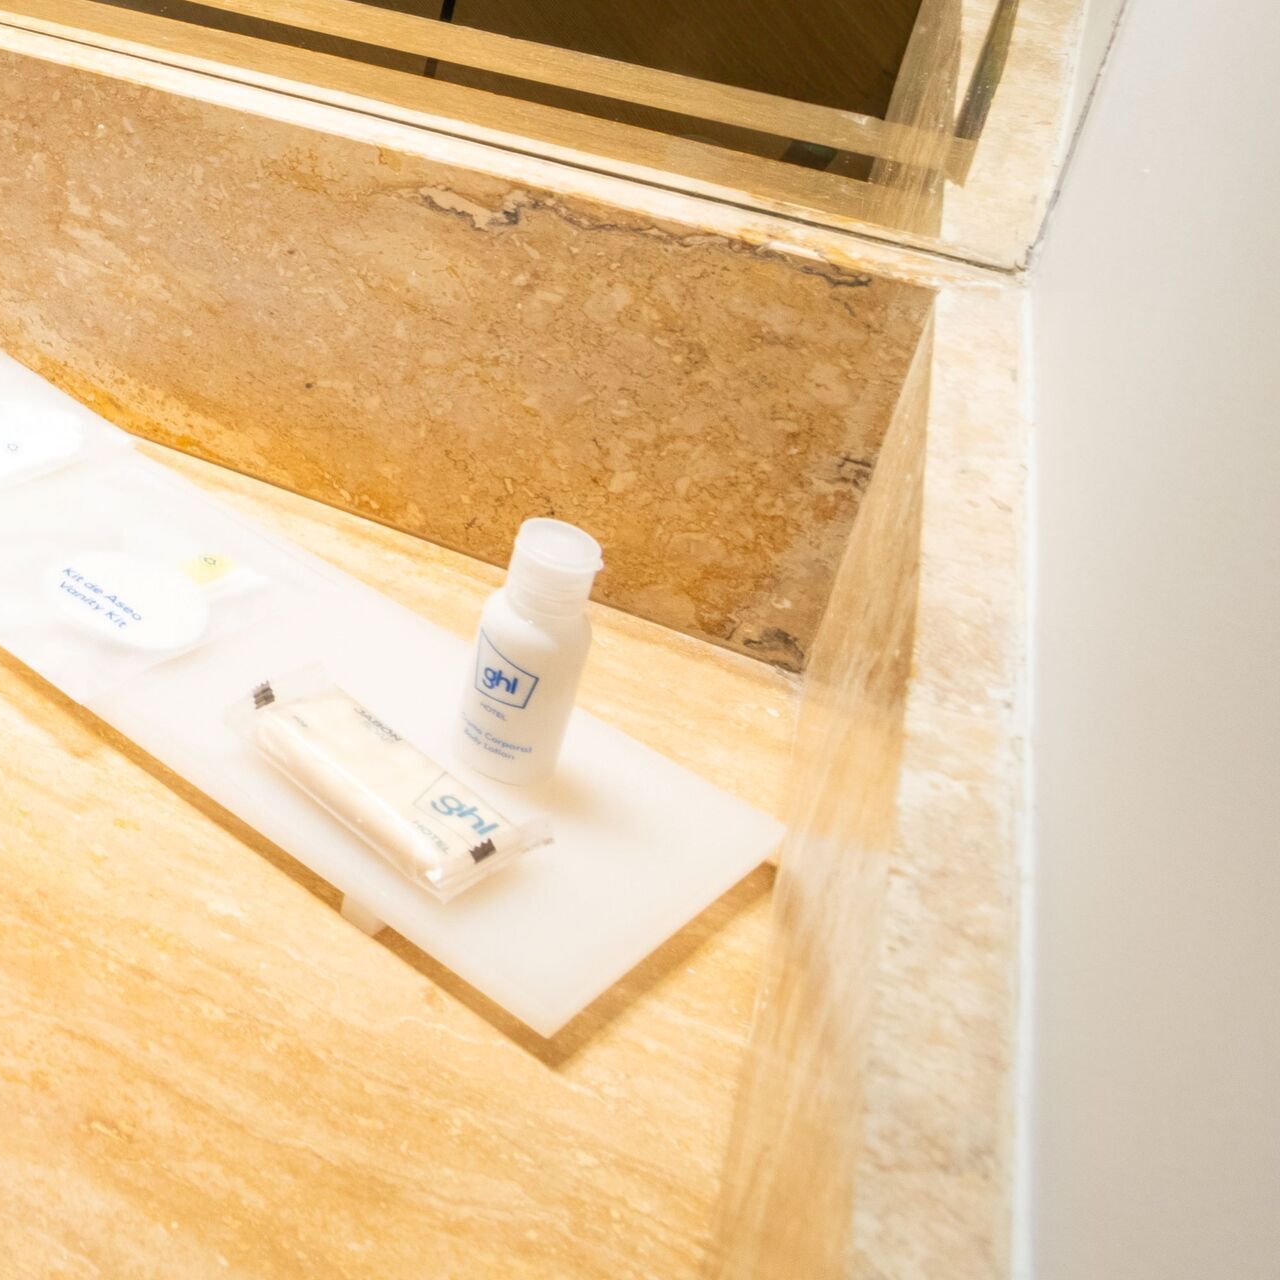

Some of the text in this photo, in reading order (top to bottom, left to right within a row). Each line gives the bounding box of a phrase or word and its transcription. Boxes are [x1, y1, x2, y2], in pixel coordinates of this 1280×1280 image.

[60, 581, 127, 628] Vanity Kit
[63, 568, 142, 620] Kit de Aseo
[482, 667, 518, 694] ghl
[480, 701, 507, 721] HOTEL
[483, 744, 515, 760] Lotion
[484, 732, 533, 753] Corporal
[431, 795, 499, 835] ghl
[413, 819, 449, 855] HOTEL
